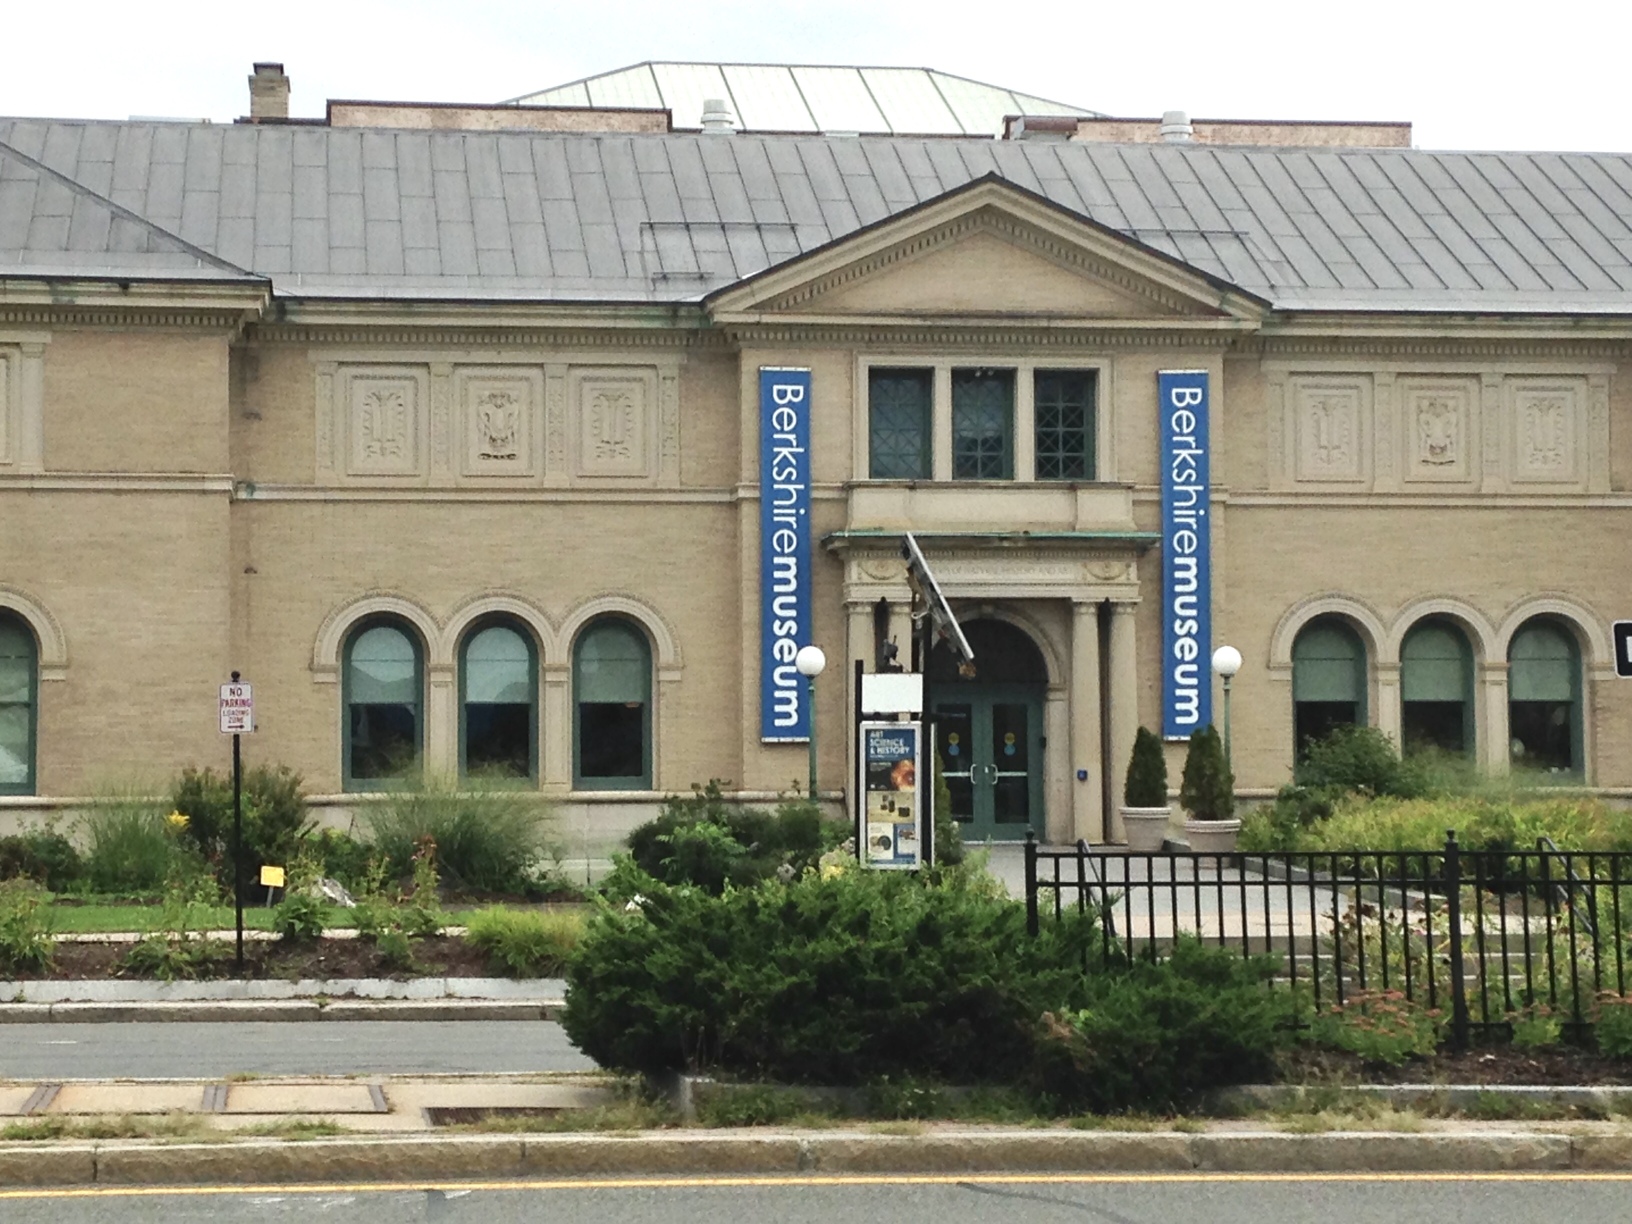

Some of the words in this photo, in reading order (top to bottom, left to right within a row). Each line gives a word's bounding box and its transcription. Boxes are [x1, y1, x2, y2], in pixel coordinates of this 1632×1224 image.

[229, 687, 243, 697] NO
[221, 699, 252, 708] PARKING
[222, 709, 249, 717] LOADING
[228, 716, 244, 724] ZONE
[869, 738, 905, 747] SCIENCE
[877, 746, 910, 755] HISTORY
